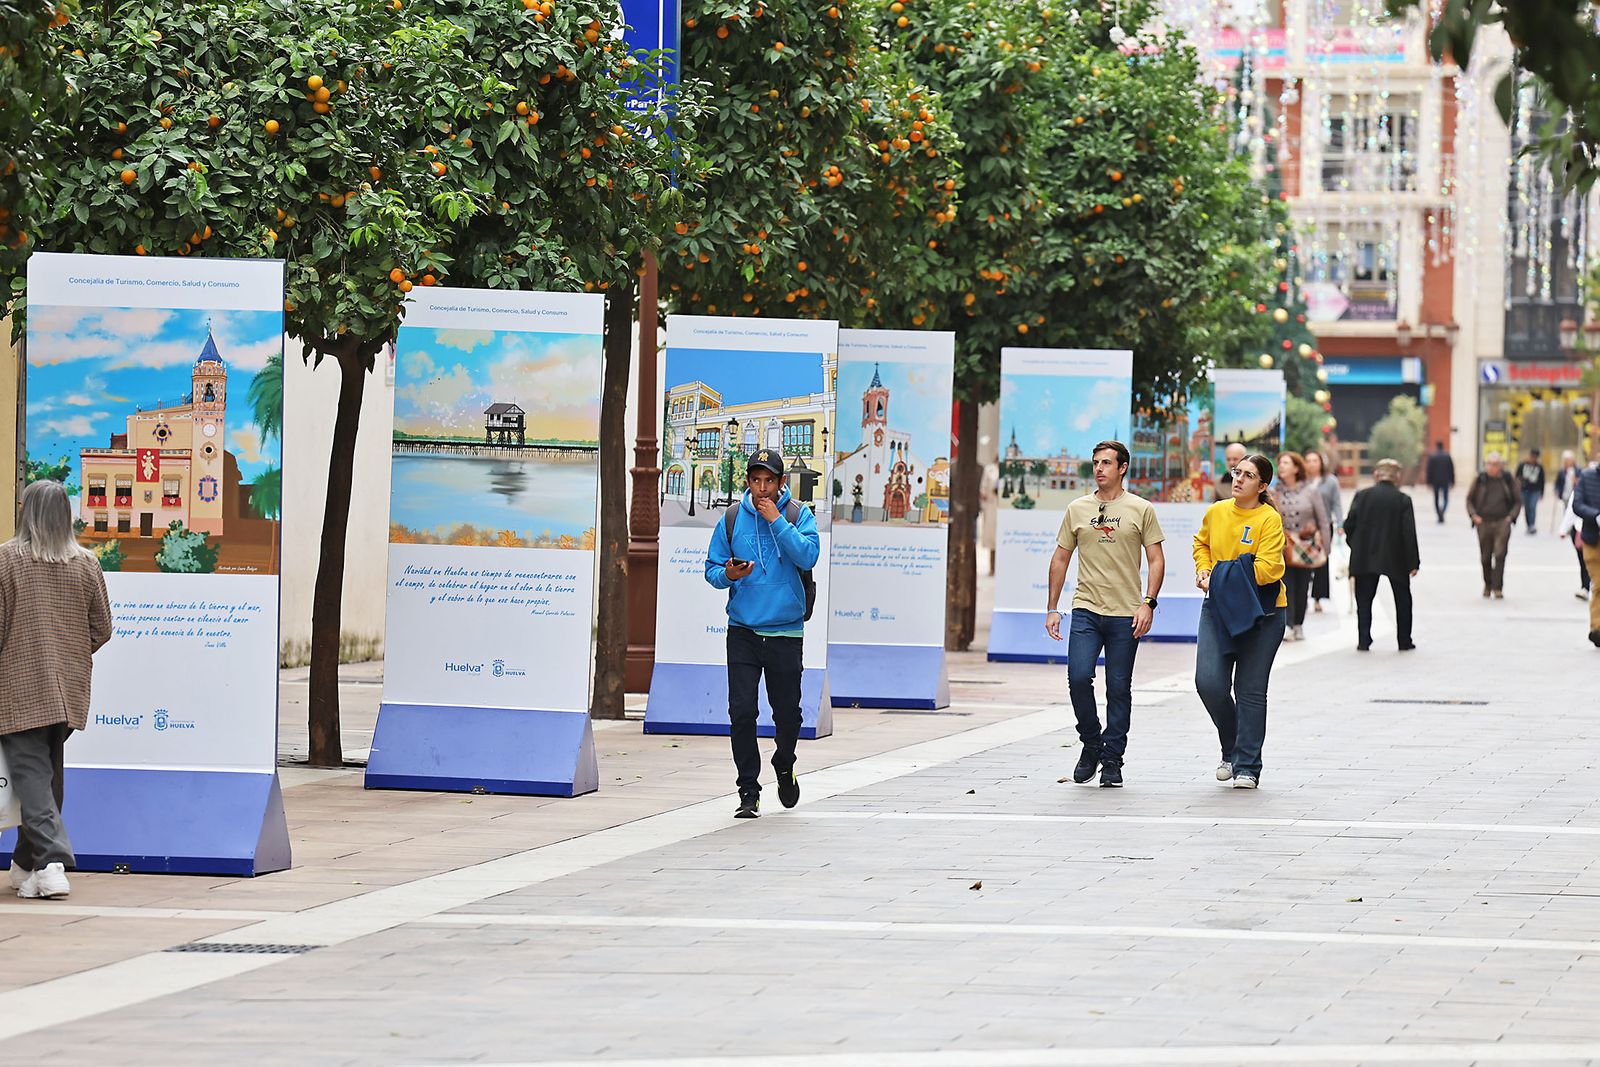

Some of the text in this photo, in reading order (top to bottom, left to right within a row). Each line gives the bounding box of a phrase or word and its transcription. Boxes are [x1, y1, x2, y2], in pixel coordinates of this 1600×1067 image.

[146, 278, 181, 286] Comercio,
[1241, 526, 1253, 545] L
[404, 565, 433, 574] Navidad
[444, 566, 468, 576] Huelva
[481, 570, 502, 580] tiempo
[504, 570, 512, 578] de
[395, 578, 405, 586] el
[405, 582, 425, 590] campo,
[438, 580, 467, 588] celebrar
[470, 580, 479, 589] el
[480, 582, 498, 592] hogar
[510, 582, 520, 590] el
[520, 582, 533, 591] olor
[545, 584, 553, 592] la
[430, 596, 436, 604] y
[438, 593, 447, 601] el
[476, 594, 483, 602] lo
[166, 601, 187, 610] abrazo
[189, 602, 196, 610] de
[199, 601, 206, 610] la
[238, 602, 247, 610] el
[137, 616, 160, 624] parece
[198, 614, 222, 622] silencio
[224, 614, 233, 622] el
[116, 627, 135, 638] hogar
[136, 630, 142, 638] y
[152, 627, 158, 636] la
[187, 628, 194, 636] de
[197, 628, 204, 636] lo
[706, 625, 727, 633] Huel
[445, 662, 481, 672] Huelva
[95, 714, 140, 726] Huelva
